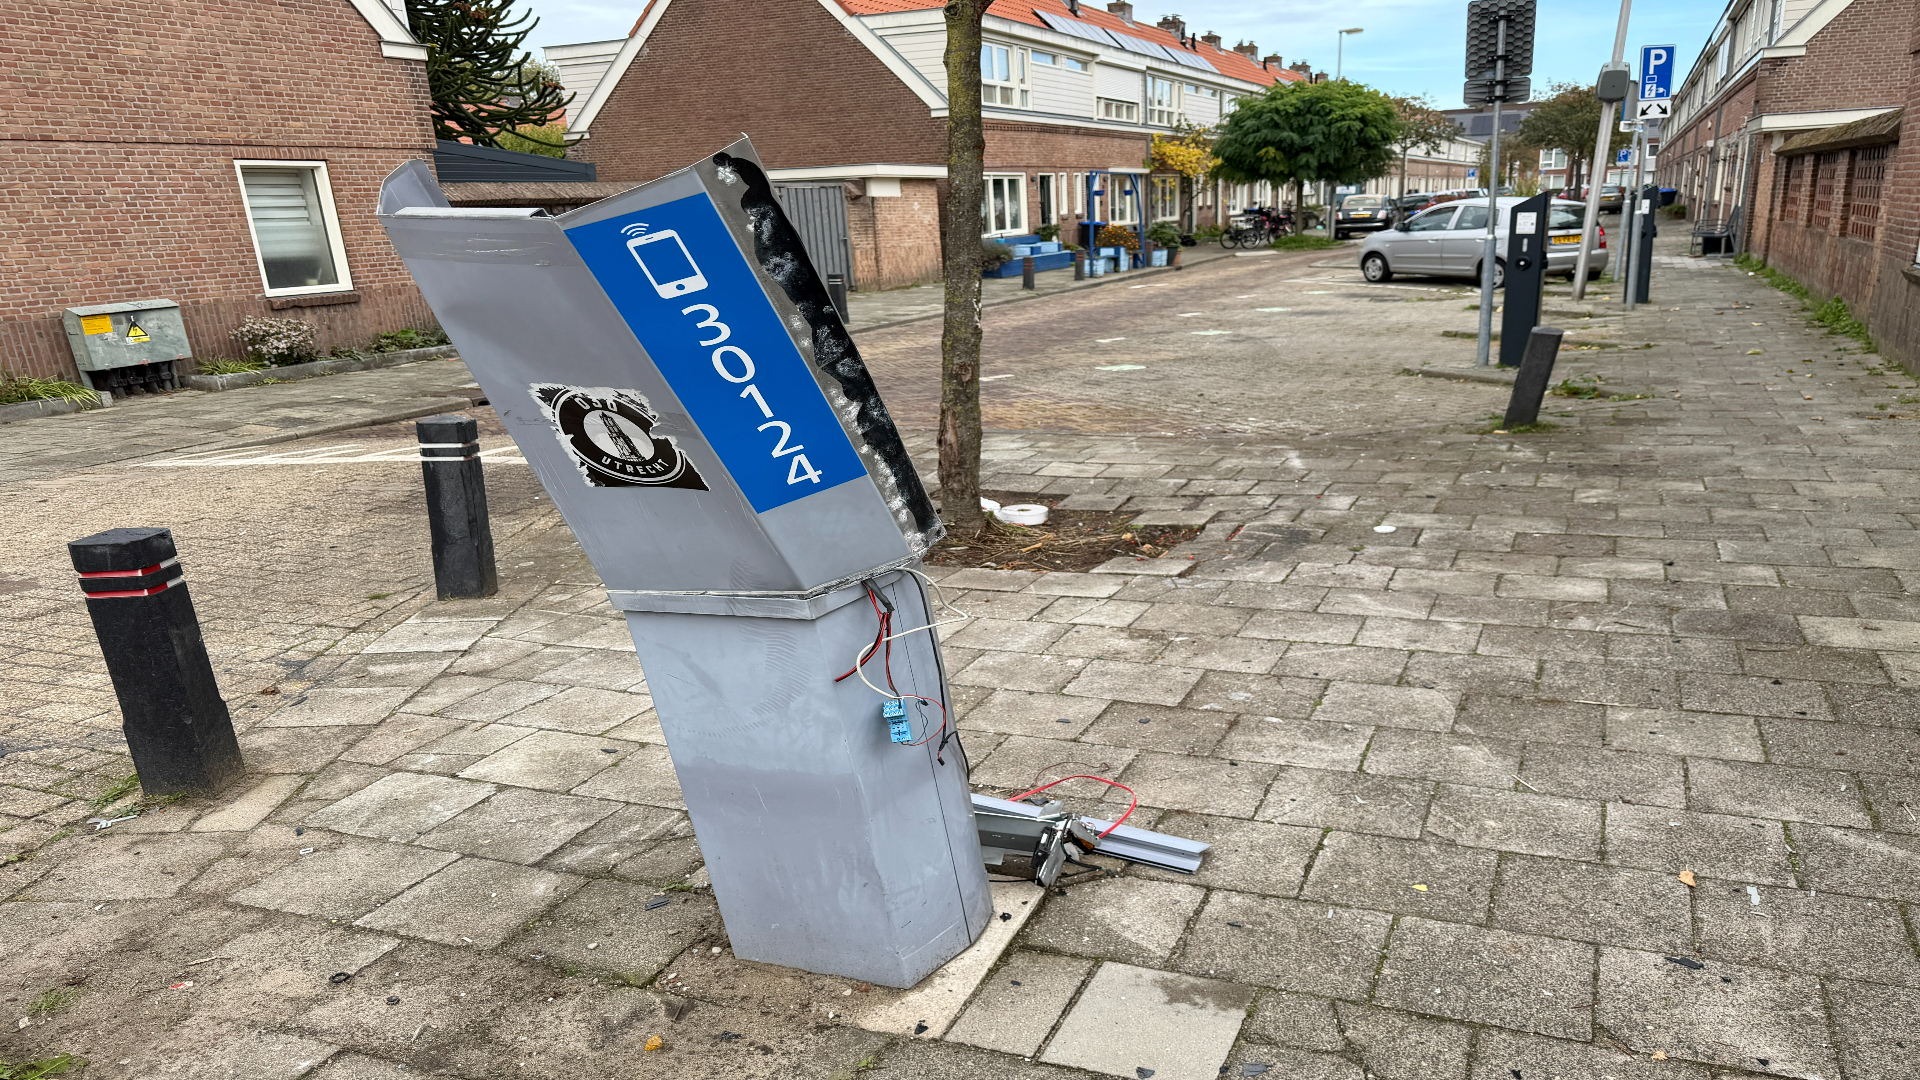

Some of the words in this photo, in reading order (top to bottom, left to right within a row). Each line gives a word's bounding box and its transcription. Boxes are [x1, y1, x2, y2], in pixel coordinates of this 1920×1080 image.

[1649, 49, 1667, 74] P
[681, 303, 823, 486] 30124
[602, 456, 670, 475] UTRECHT
